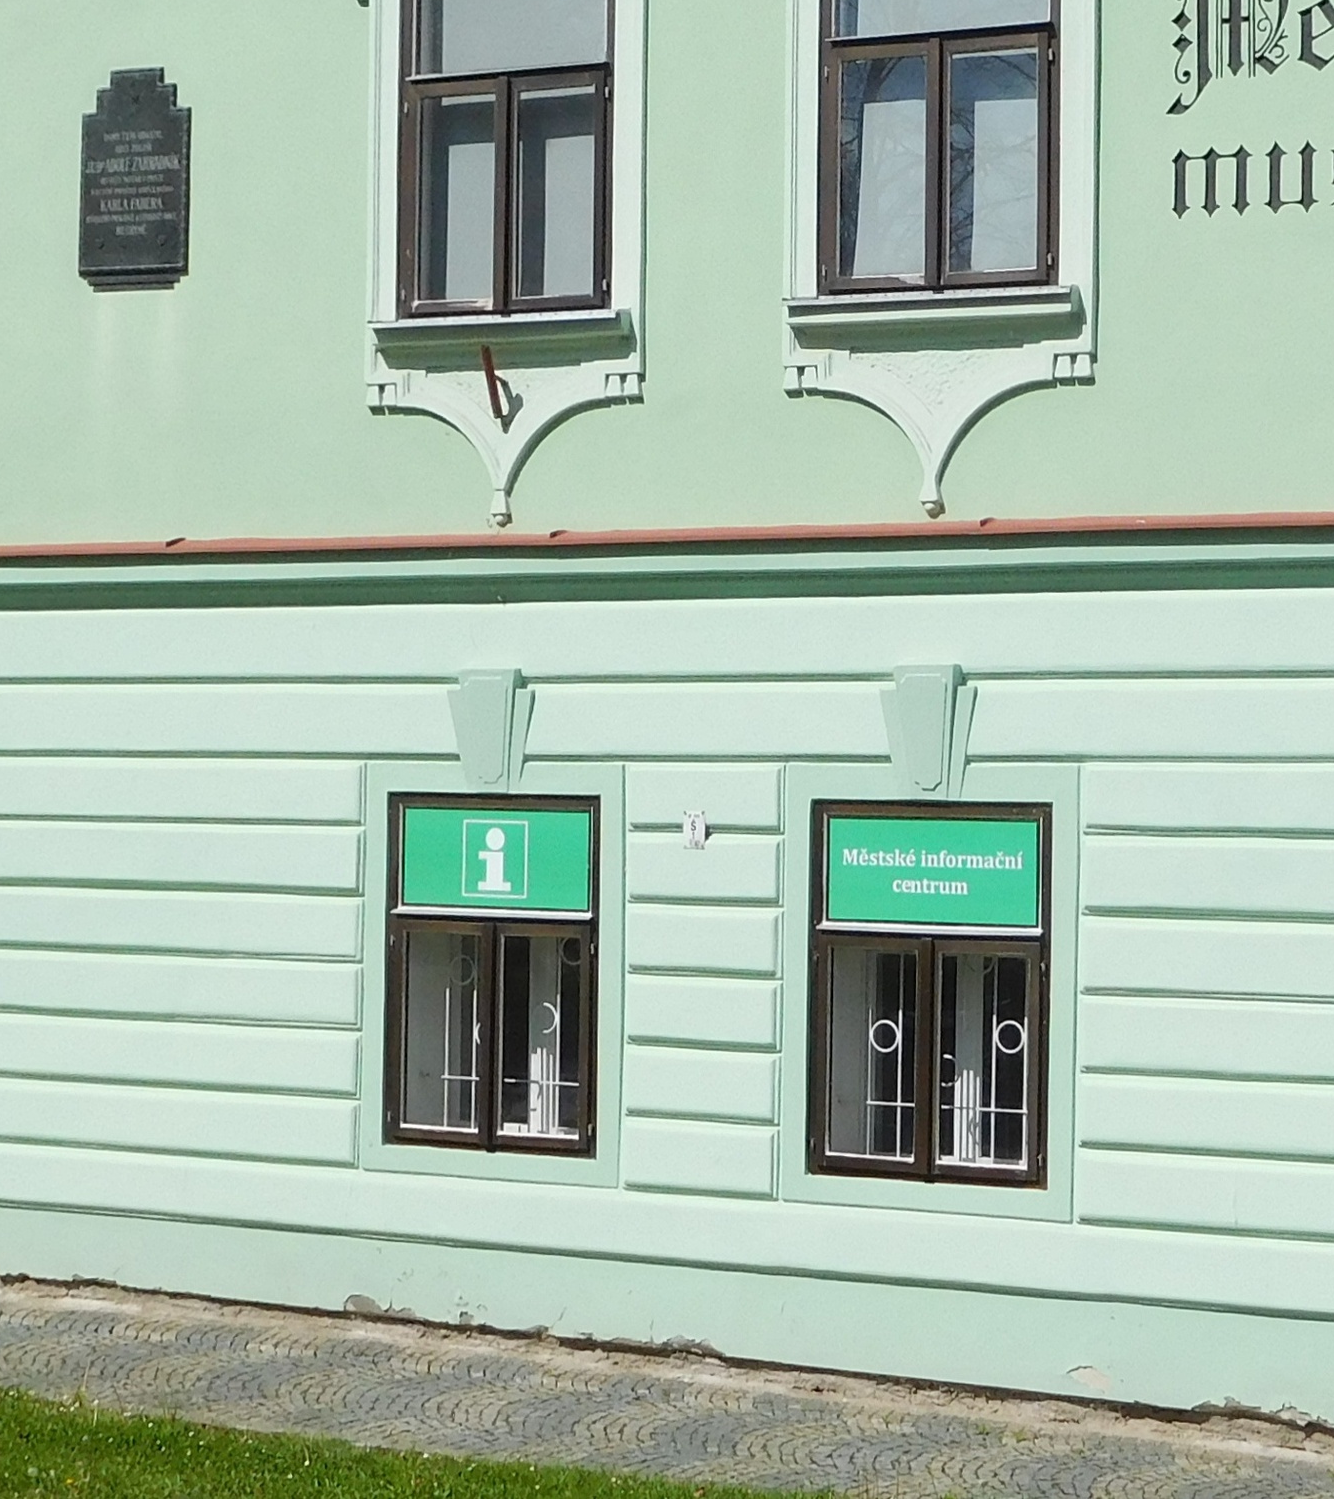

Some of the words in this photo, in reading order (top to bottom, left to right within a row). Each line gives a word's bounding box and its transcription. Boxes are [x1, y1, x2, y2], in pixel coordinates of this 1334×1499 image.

[842, 848, 916, 867] Městské
[921, 850, 1024, 870] informační
[892, 878, 968, 895] centrum
